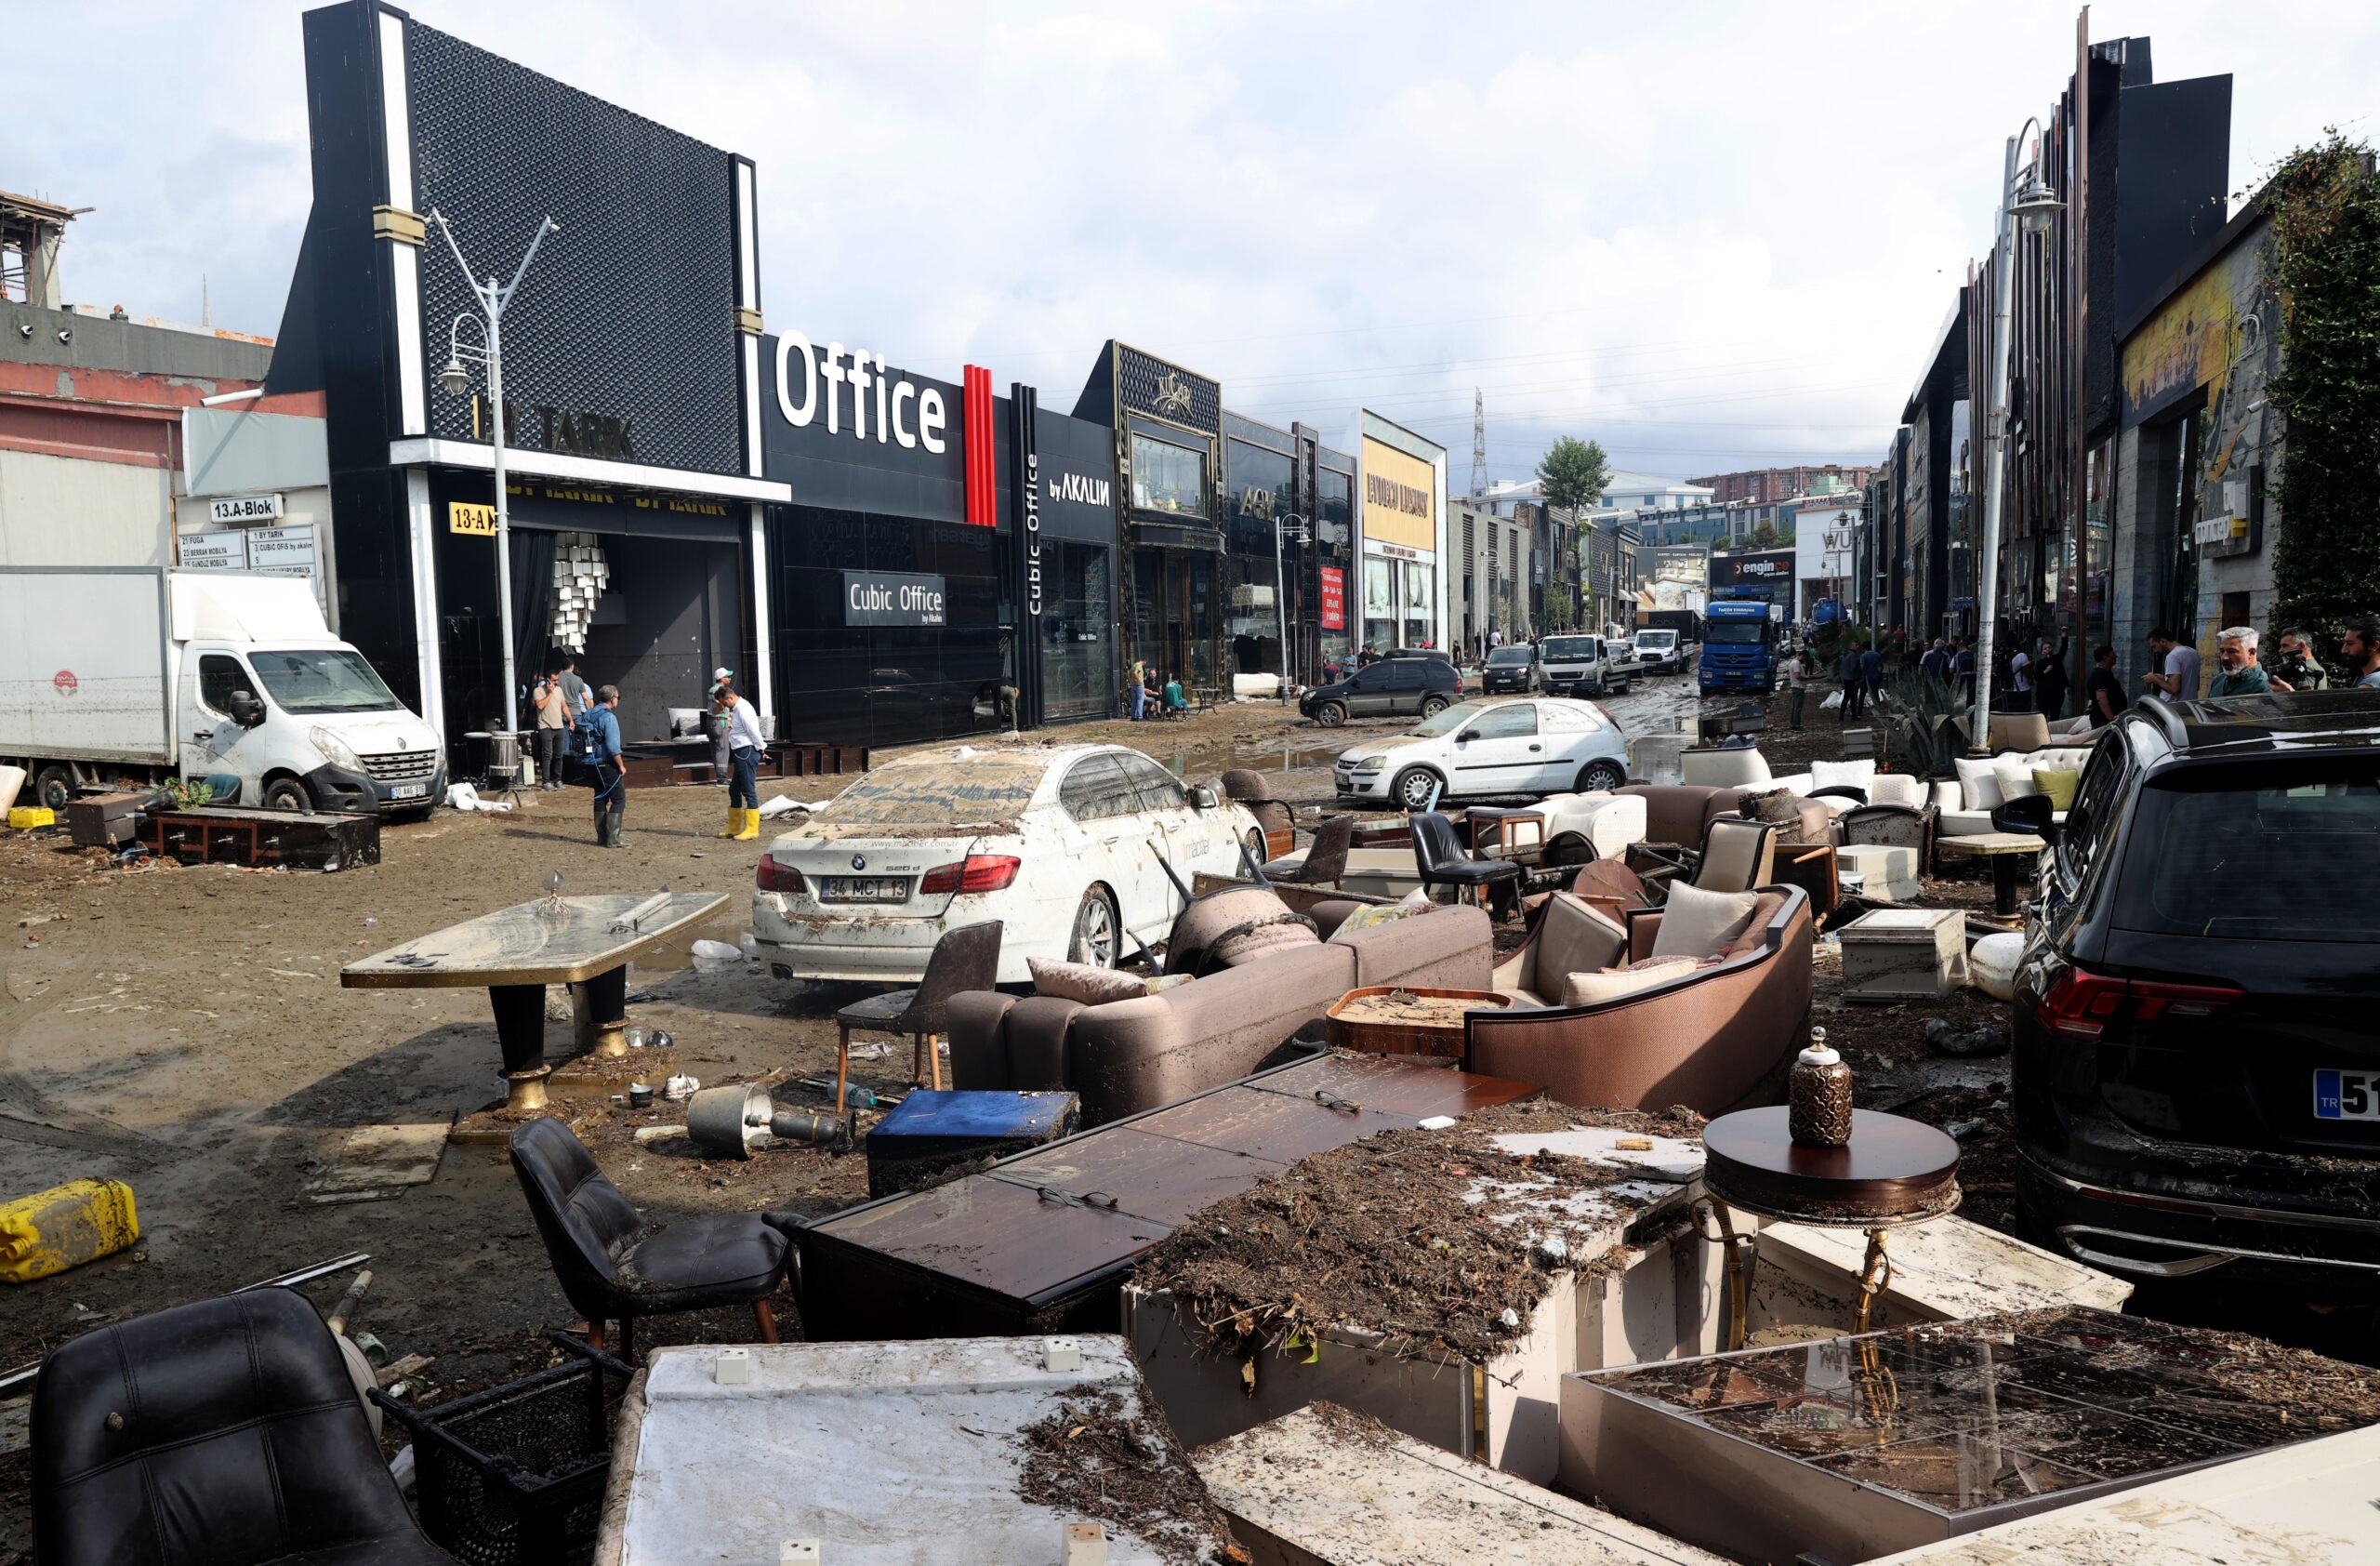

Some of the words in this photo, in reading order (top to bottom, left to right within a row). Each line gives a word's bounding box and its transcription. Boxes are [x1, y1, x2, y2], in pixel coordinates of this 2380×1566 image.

[776, 329, 945, 454] Office
[1026, 453, 1038, 532] Office
[1049, 479, 1061, 502] by
[1062, 472, 1110, 508] AKALIN
[215, 500, 272, 518] 13.A-Blok
[456, 508, 485, 530] 13-A
[259, 531, 268, 539] BY
[1029, 545, 1041, 616] Cubic
[850, 583, 892, 611] Cubic
[899, 585, 943, 611] Office
[830, 880, 847, 896] 34
[853, 880, 884, 896] MCT
[892, 880, 906, 896] 13
[2320, 1097, 2339, 1108] TR
